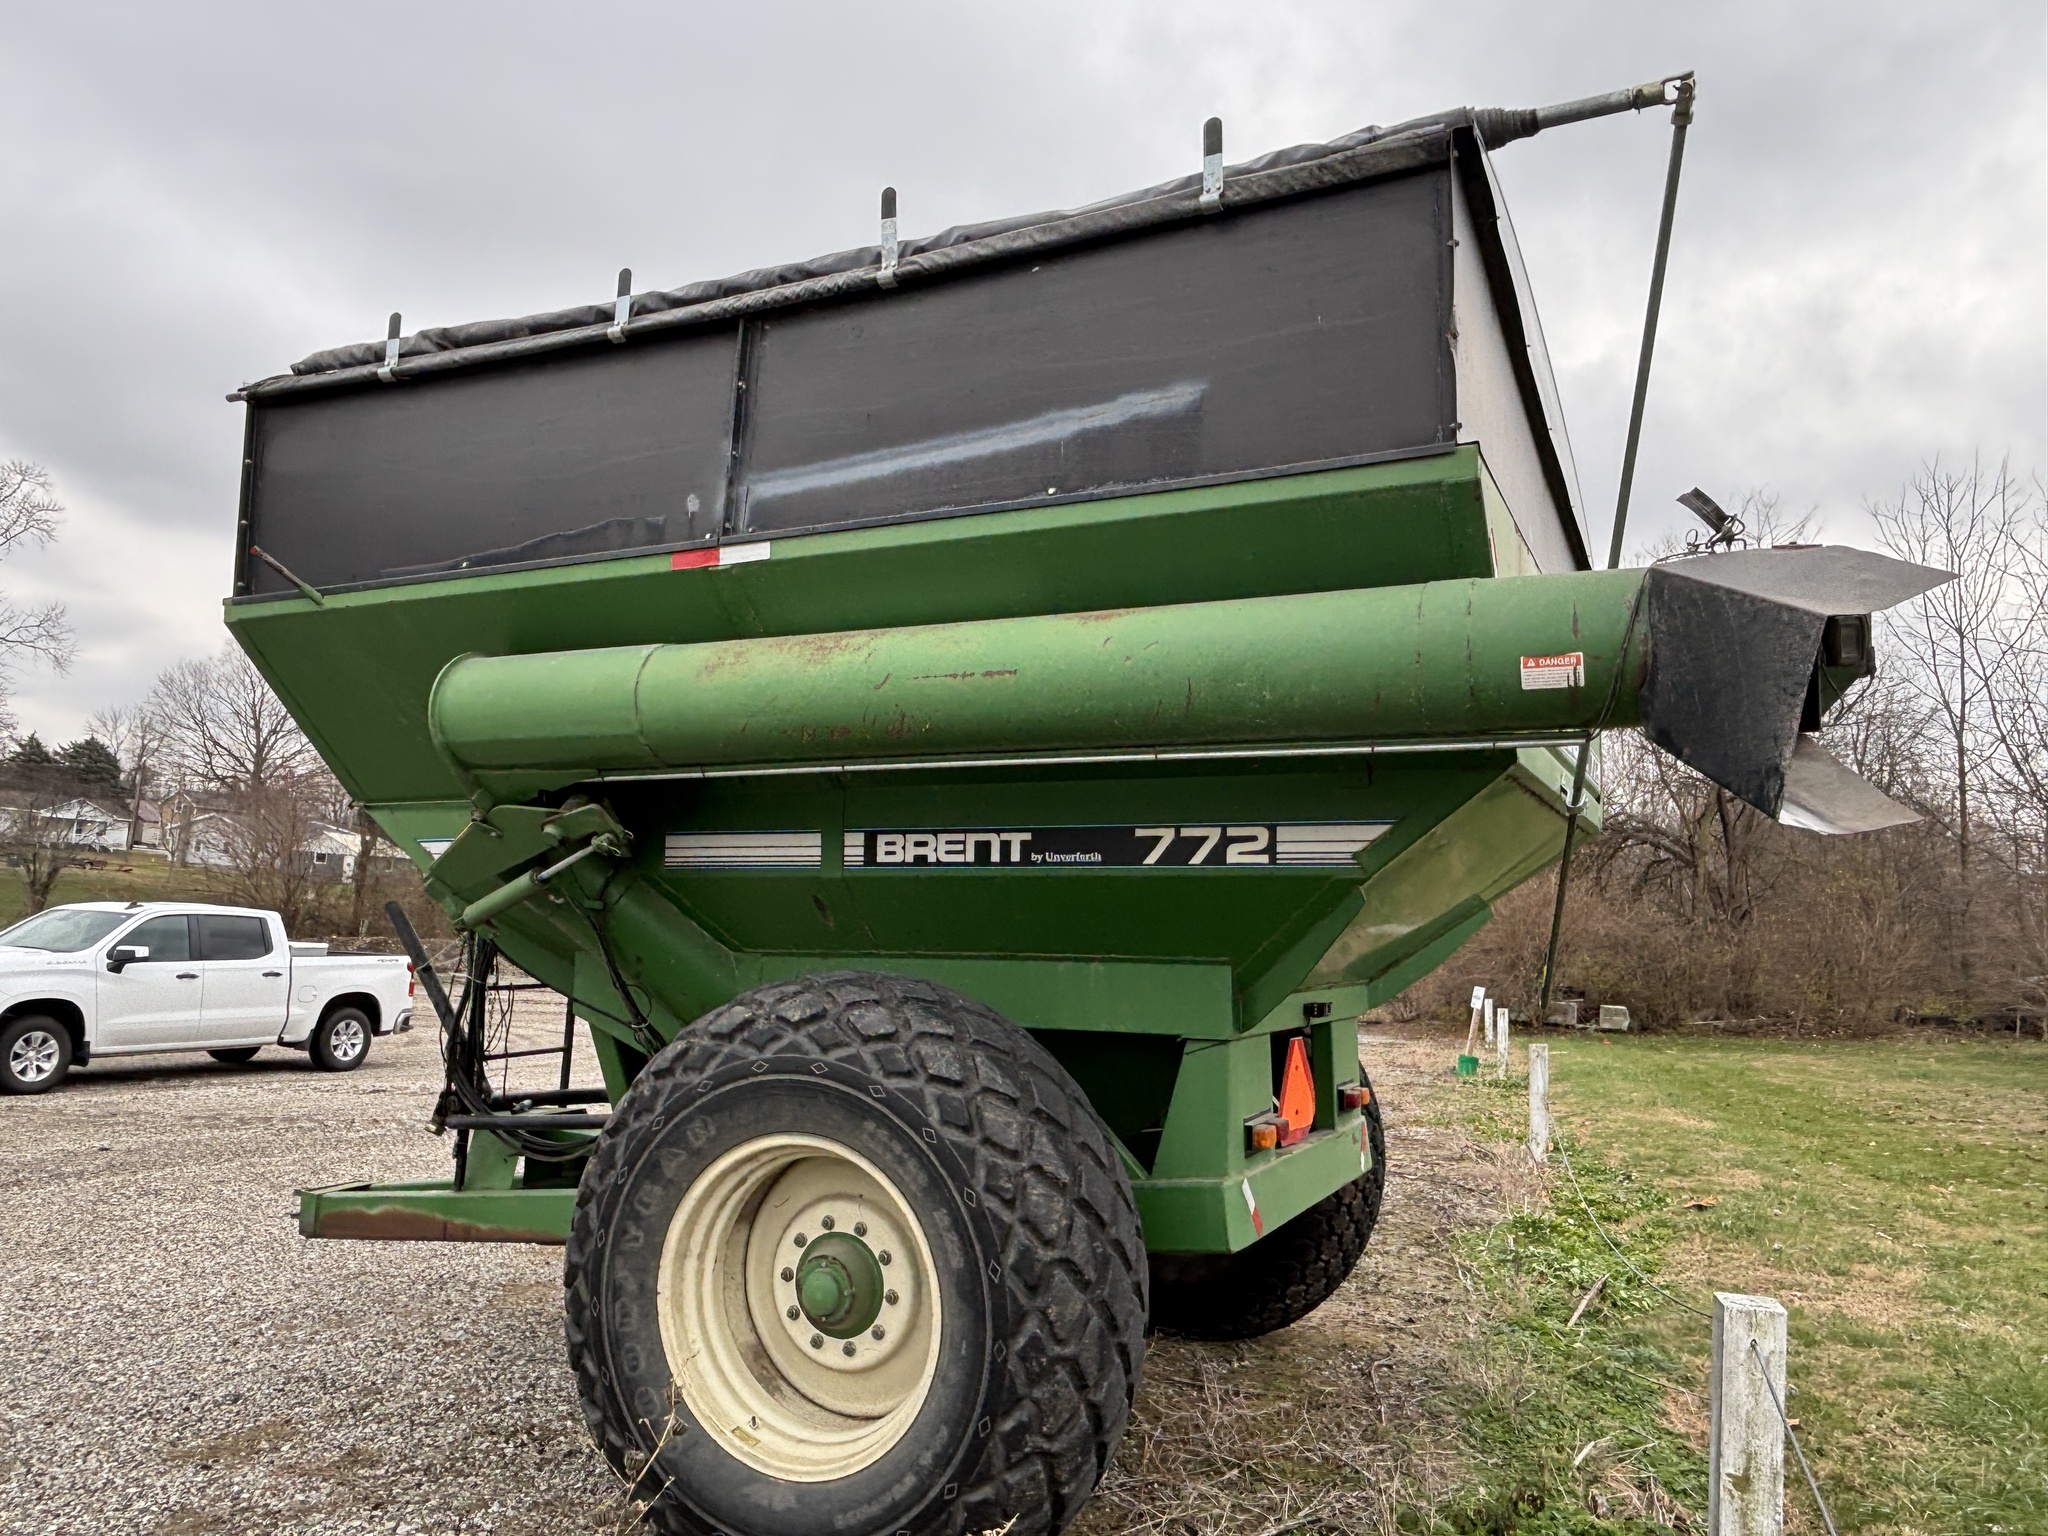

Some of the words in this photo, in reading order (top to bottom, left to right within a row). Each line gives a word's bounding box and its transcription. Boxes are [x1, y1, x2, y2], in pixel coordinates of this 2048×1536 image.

[1539, 657, 1577, 666] DANGER
[876, 832, 1032, 863] BRENT
[1031, 852, 1044, 864] by
[1134, 826, 1270, 865] 772
